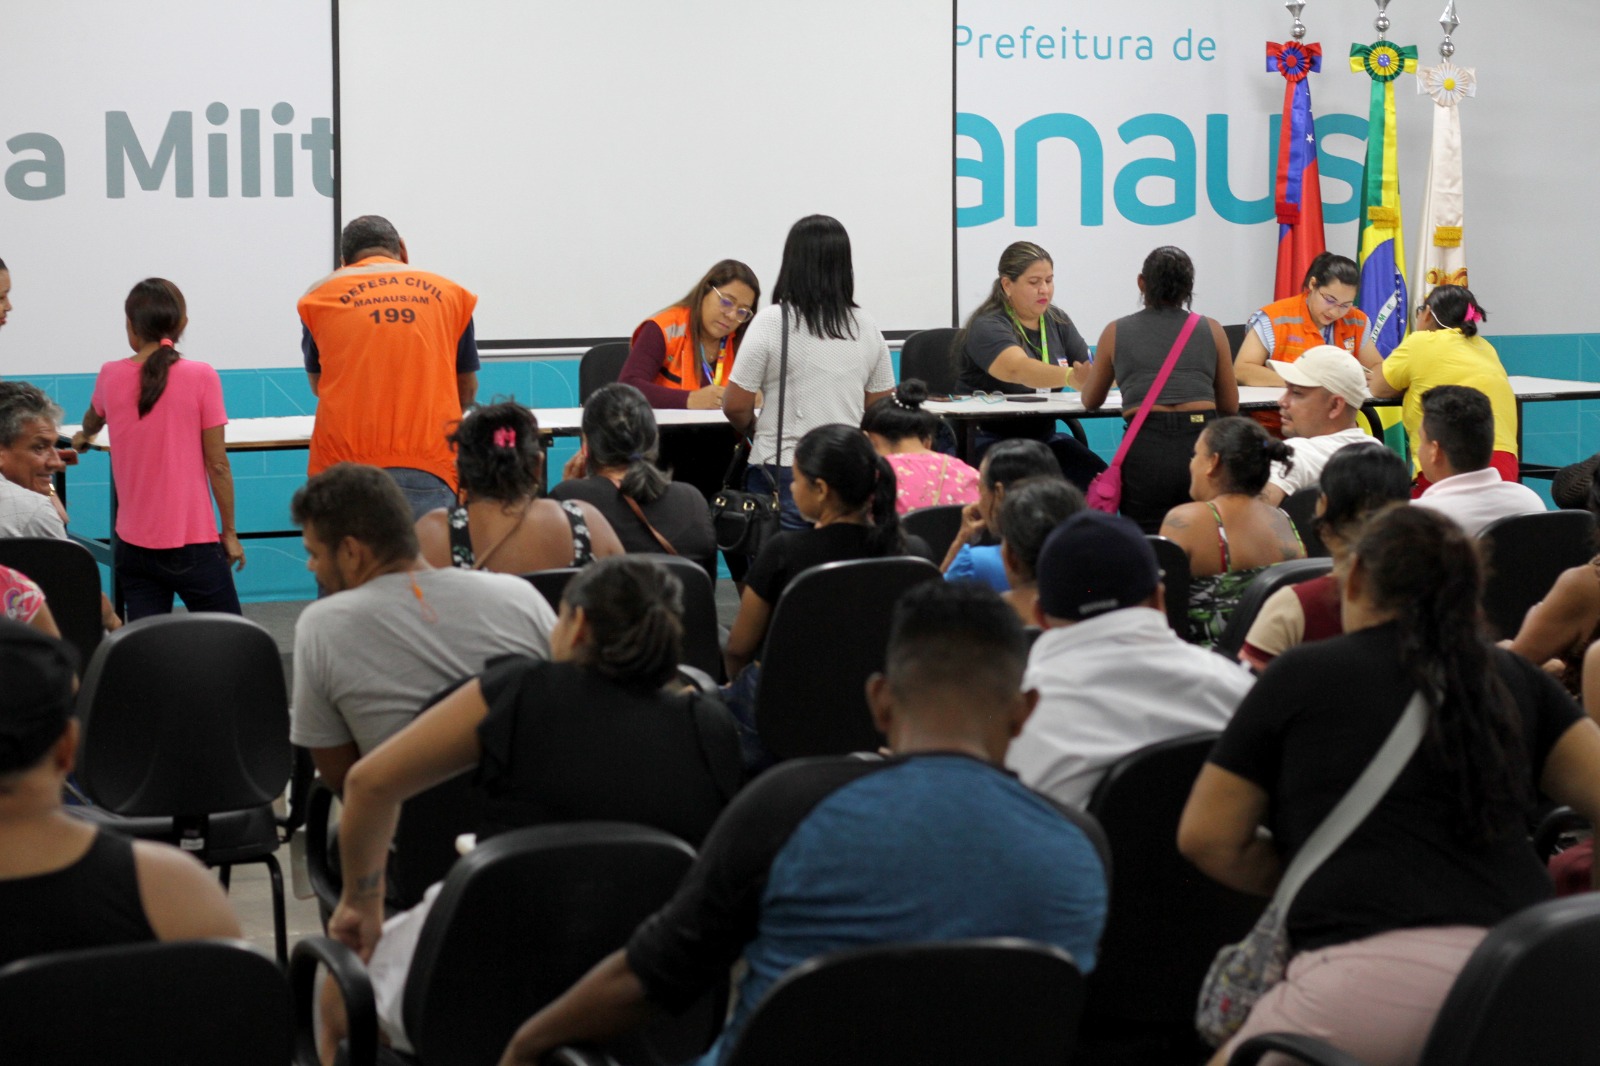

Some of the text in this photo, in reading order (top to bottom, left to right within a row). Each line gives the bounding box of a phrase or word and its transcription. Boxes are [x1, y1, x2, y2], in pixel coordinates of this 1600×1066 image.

[956, 25, 1217, 61] Prefeitura de
[4, 132, 66, 201] a
[339, 276, 442, 305] DEFESA CIVIL
[369, 307, 416, 325] 199
